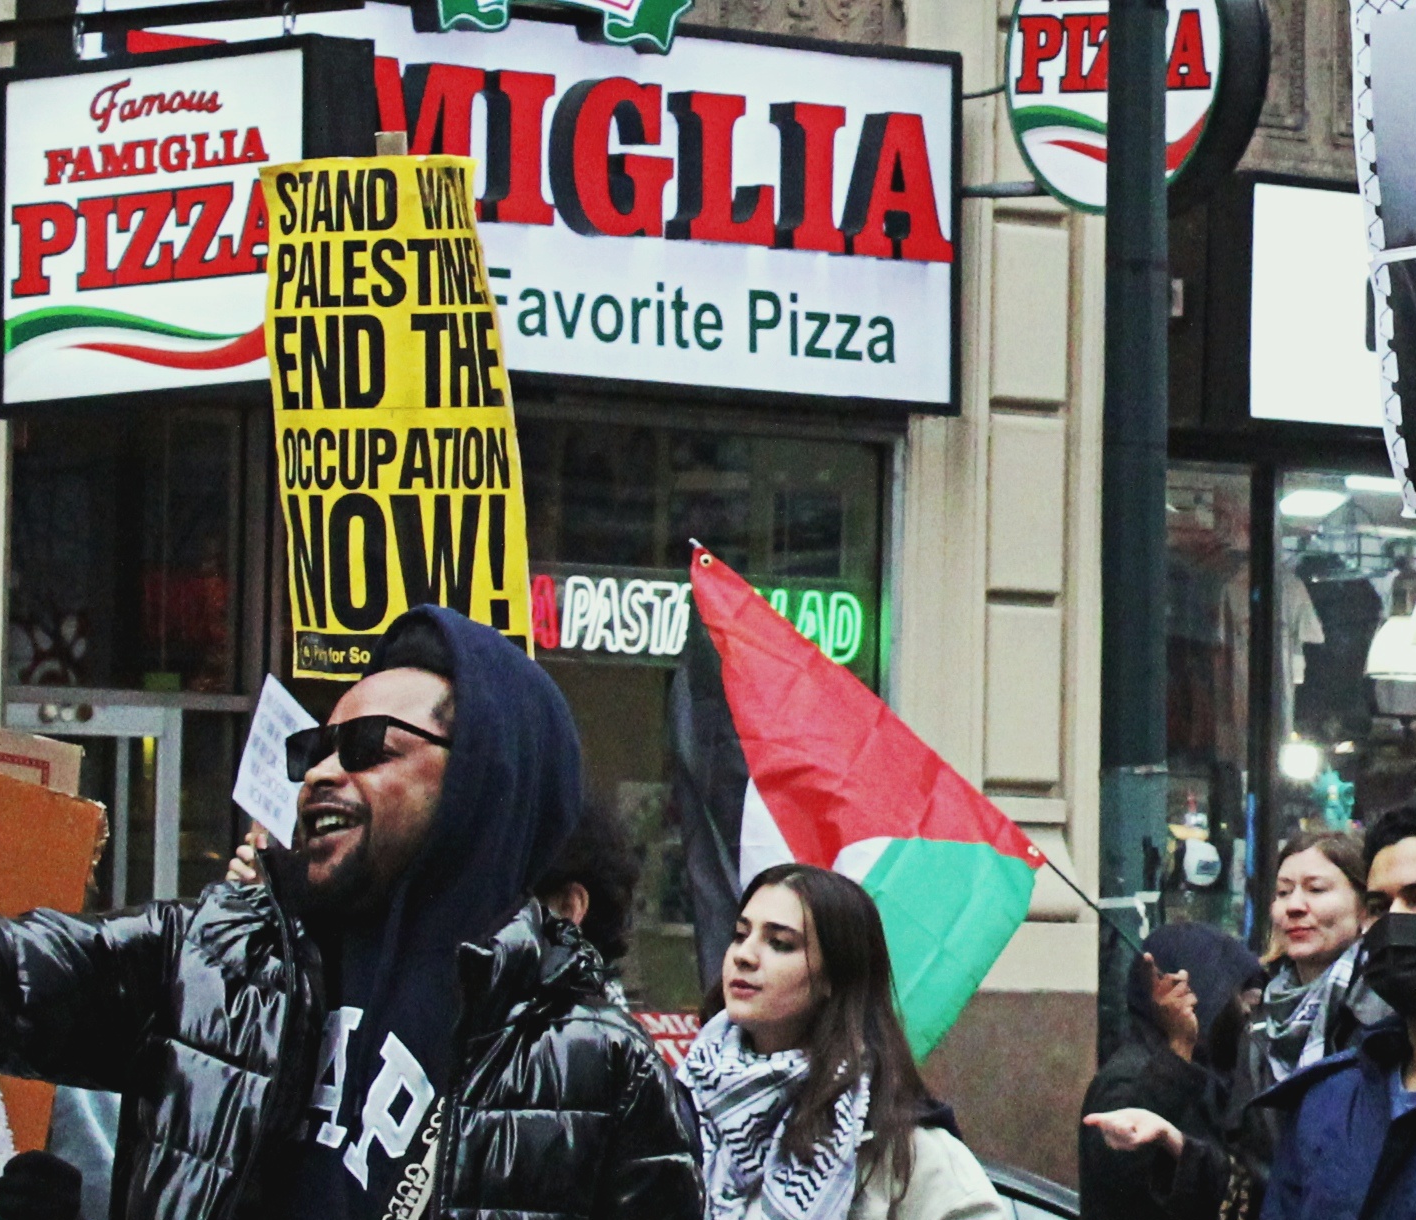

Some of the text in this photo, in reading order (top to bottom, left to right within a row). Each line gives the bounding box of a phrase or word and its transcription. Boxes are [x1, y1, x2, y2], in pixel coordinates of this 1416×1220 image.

[1014, 9, 1212, 94] PIZA
[89, 79, 223, 133] Famous
[44, 127, 270, 186] FAMIGLIA
[11, 179, 269, 299] PIZZA
[276, 168, 398, 235] STAND
[275, 311, 505, 409] END THE
[748, 289, 896, 364] Pizza
[284, 428, 511, 490] OCCUPATION
[287, 493, 511, 631] NOW!
